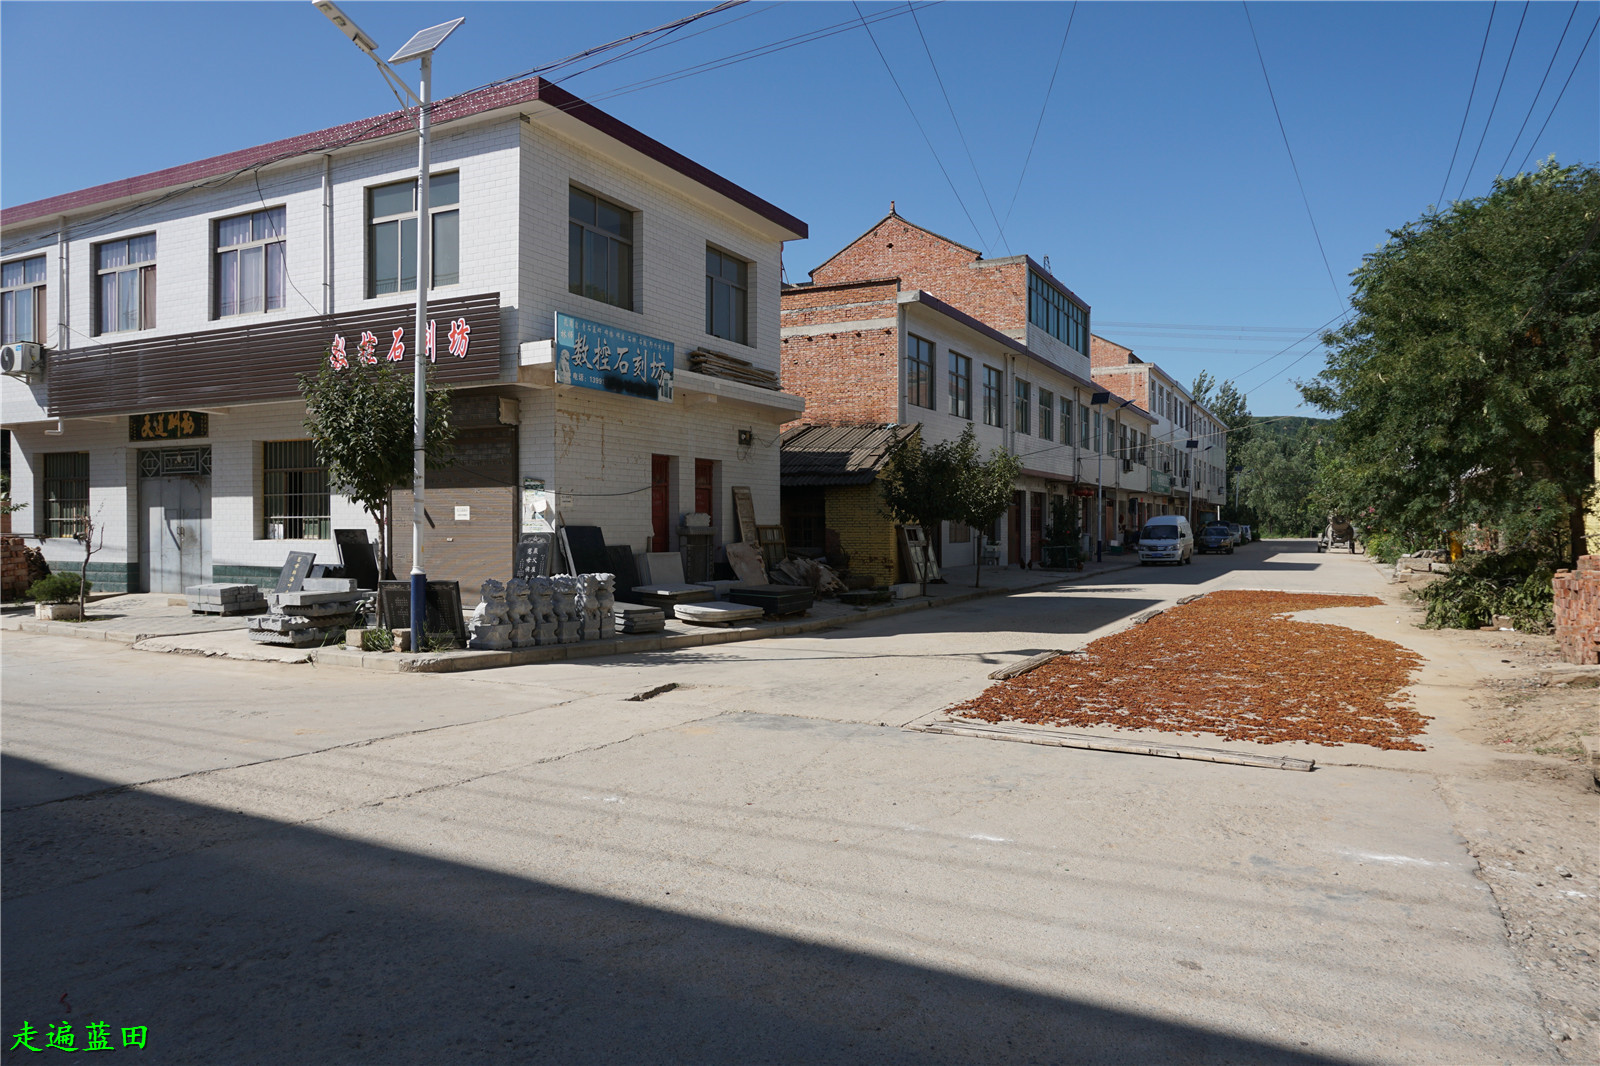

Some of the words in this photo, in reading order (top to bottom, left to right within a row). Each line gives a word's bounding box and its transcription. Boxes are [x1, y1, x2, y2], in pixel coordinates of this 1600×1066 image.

[572, 332, 667, 385] 数控石刻坊
